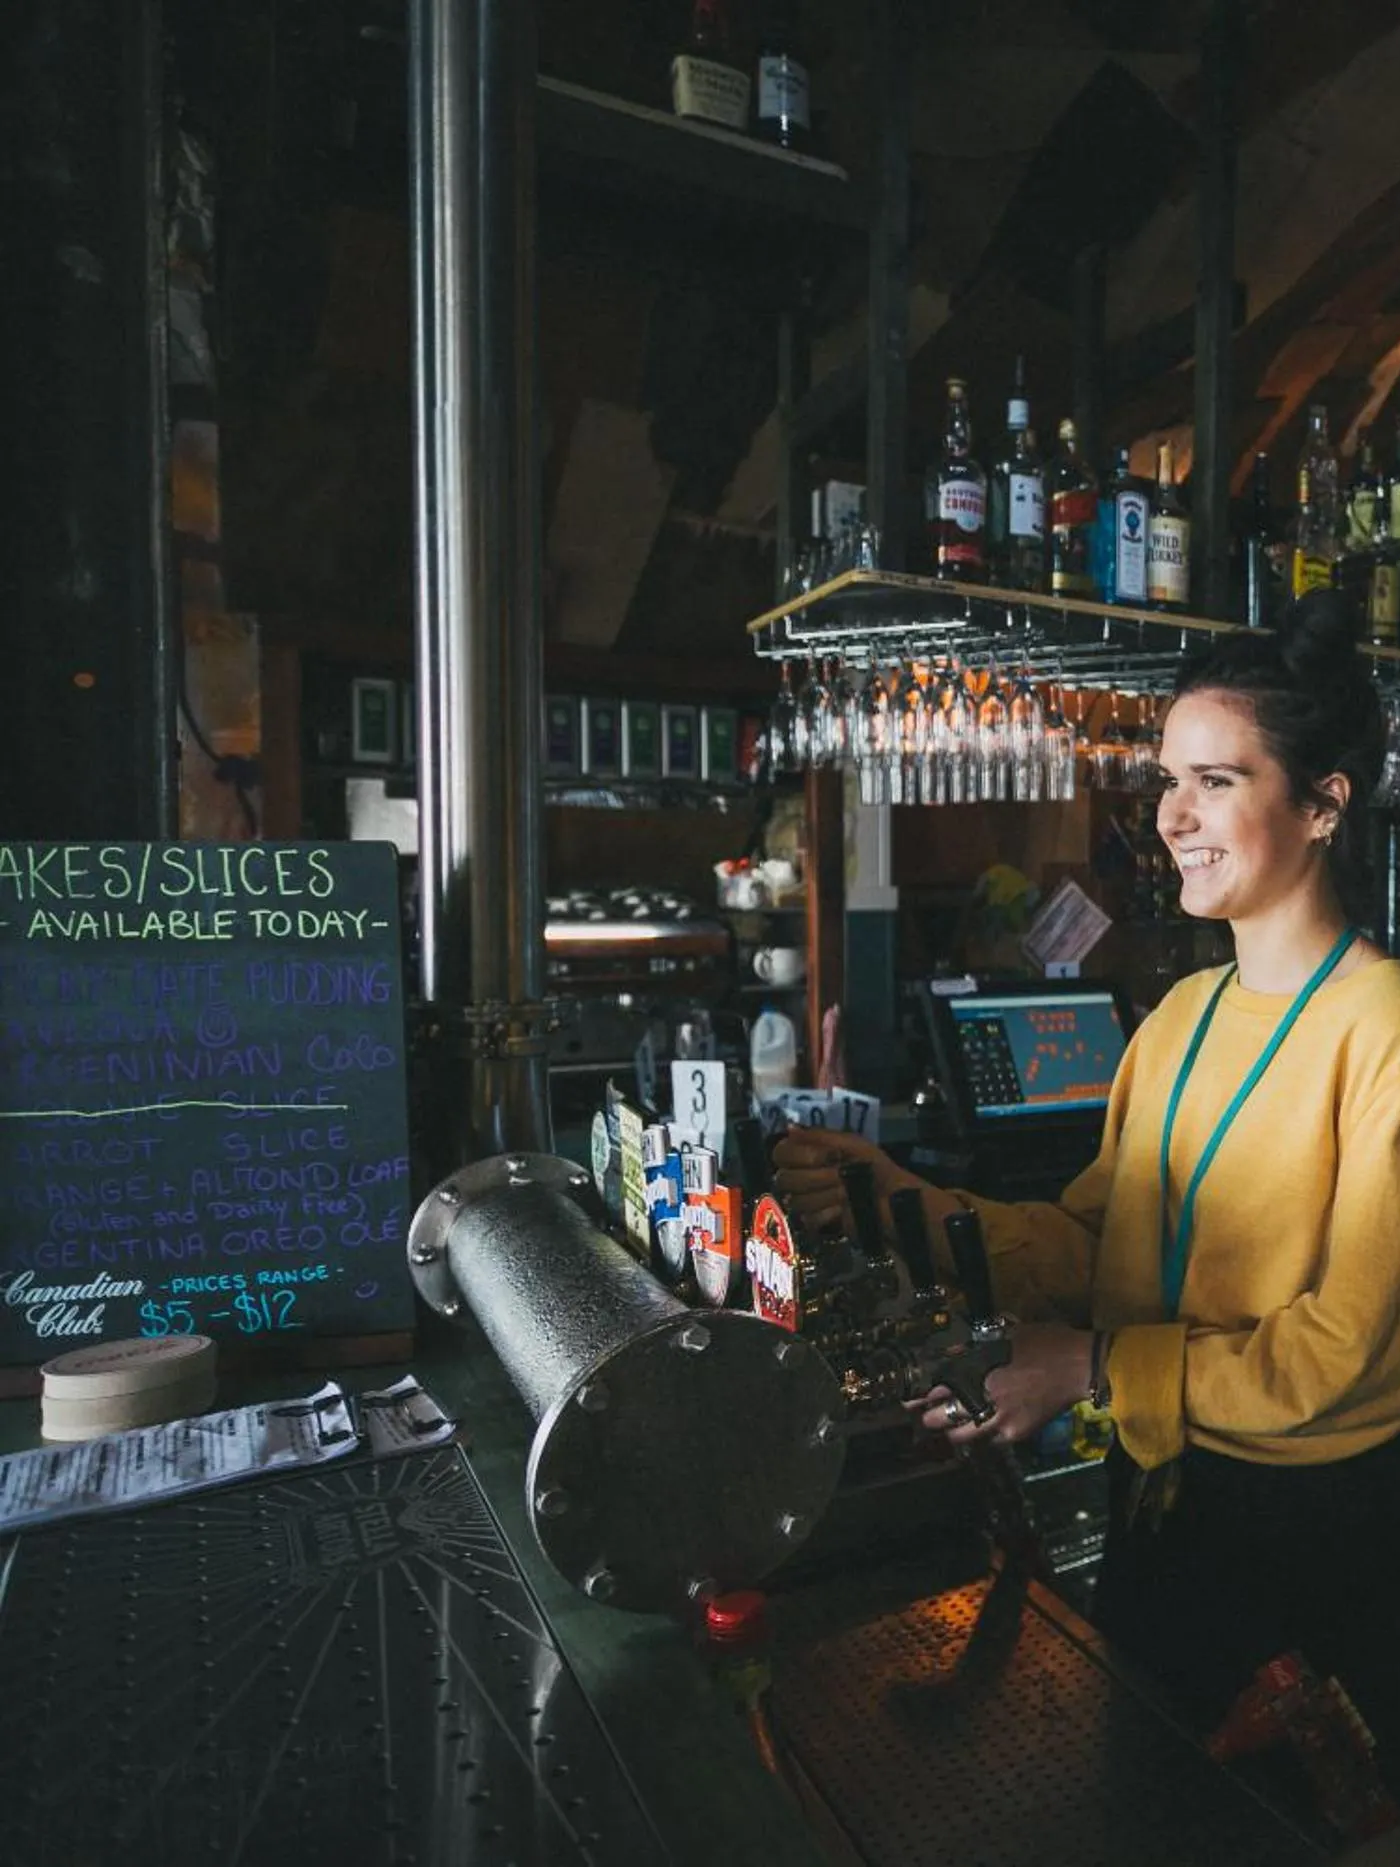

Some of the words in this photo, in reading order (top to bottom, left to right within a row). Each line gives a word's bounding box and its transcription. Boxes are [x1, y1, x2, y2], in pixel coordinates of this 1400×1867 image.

[1152, 532, 1179, 549] WILD
[28, 909, 236, 940] AVAILABLE
[246, 959, 392, 1006] PUDDING
[691, 1069, 707, 1113] 3
[843, 1096, 869, 1136] 17
[221, 1123, 351, 1161] SLICE
[190, 1161, 340, 1196] ALMOND
[347, 1156, 410, 1188] LOAF
[151, 1199, 199, 1227] and
[220, 1224, 327, 1257] OREO
[3, 1269, 144, 1304] Canadian
